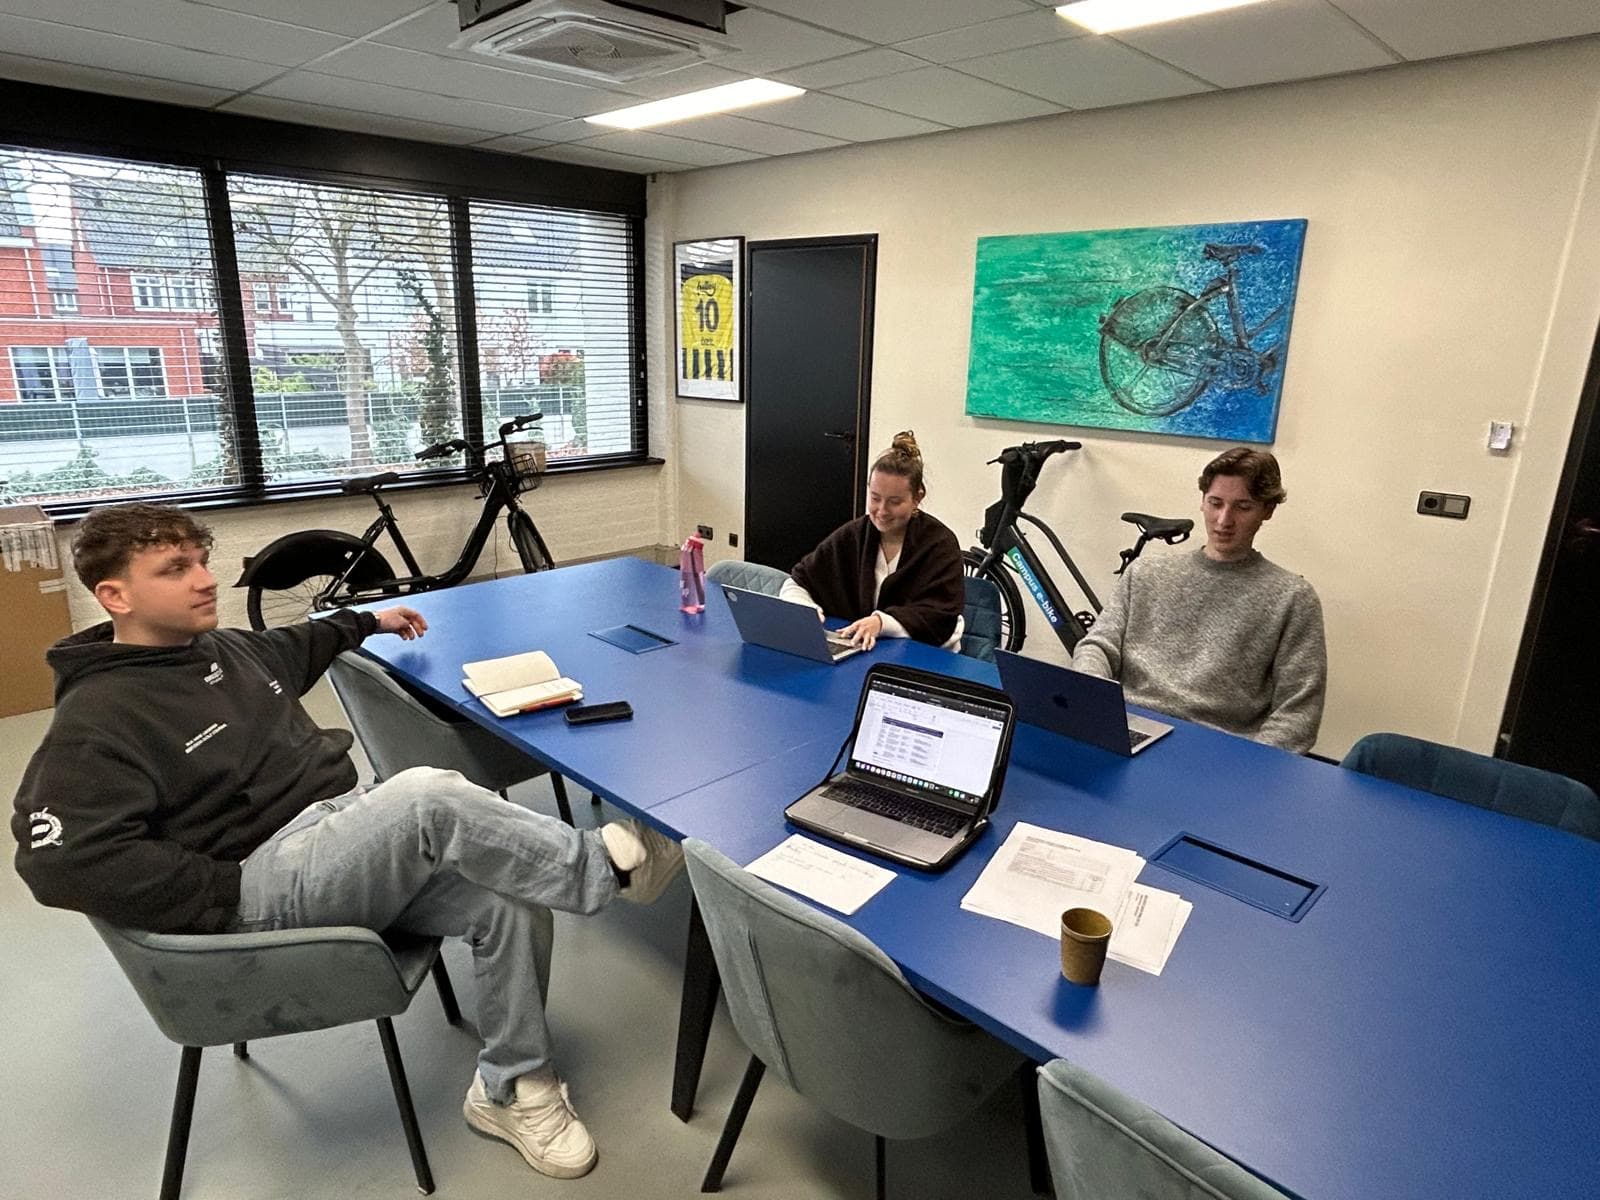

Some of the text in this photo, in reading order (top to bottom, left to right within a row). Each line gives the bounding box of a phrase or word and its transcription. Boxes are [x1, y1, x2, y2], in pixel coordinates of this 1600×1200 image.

[695, 299, 719, 332] 10
[1012, 553, 1058, 623] Campus e-bike
